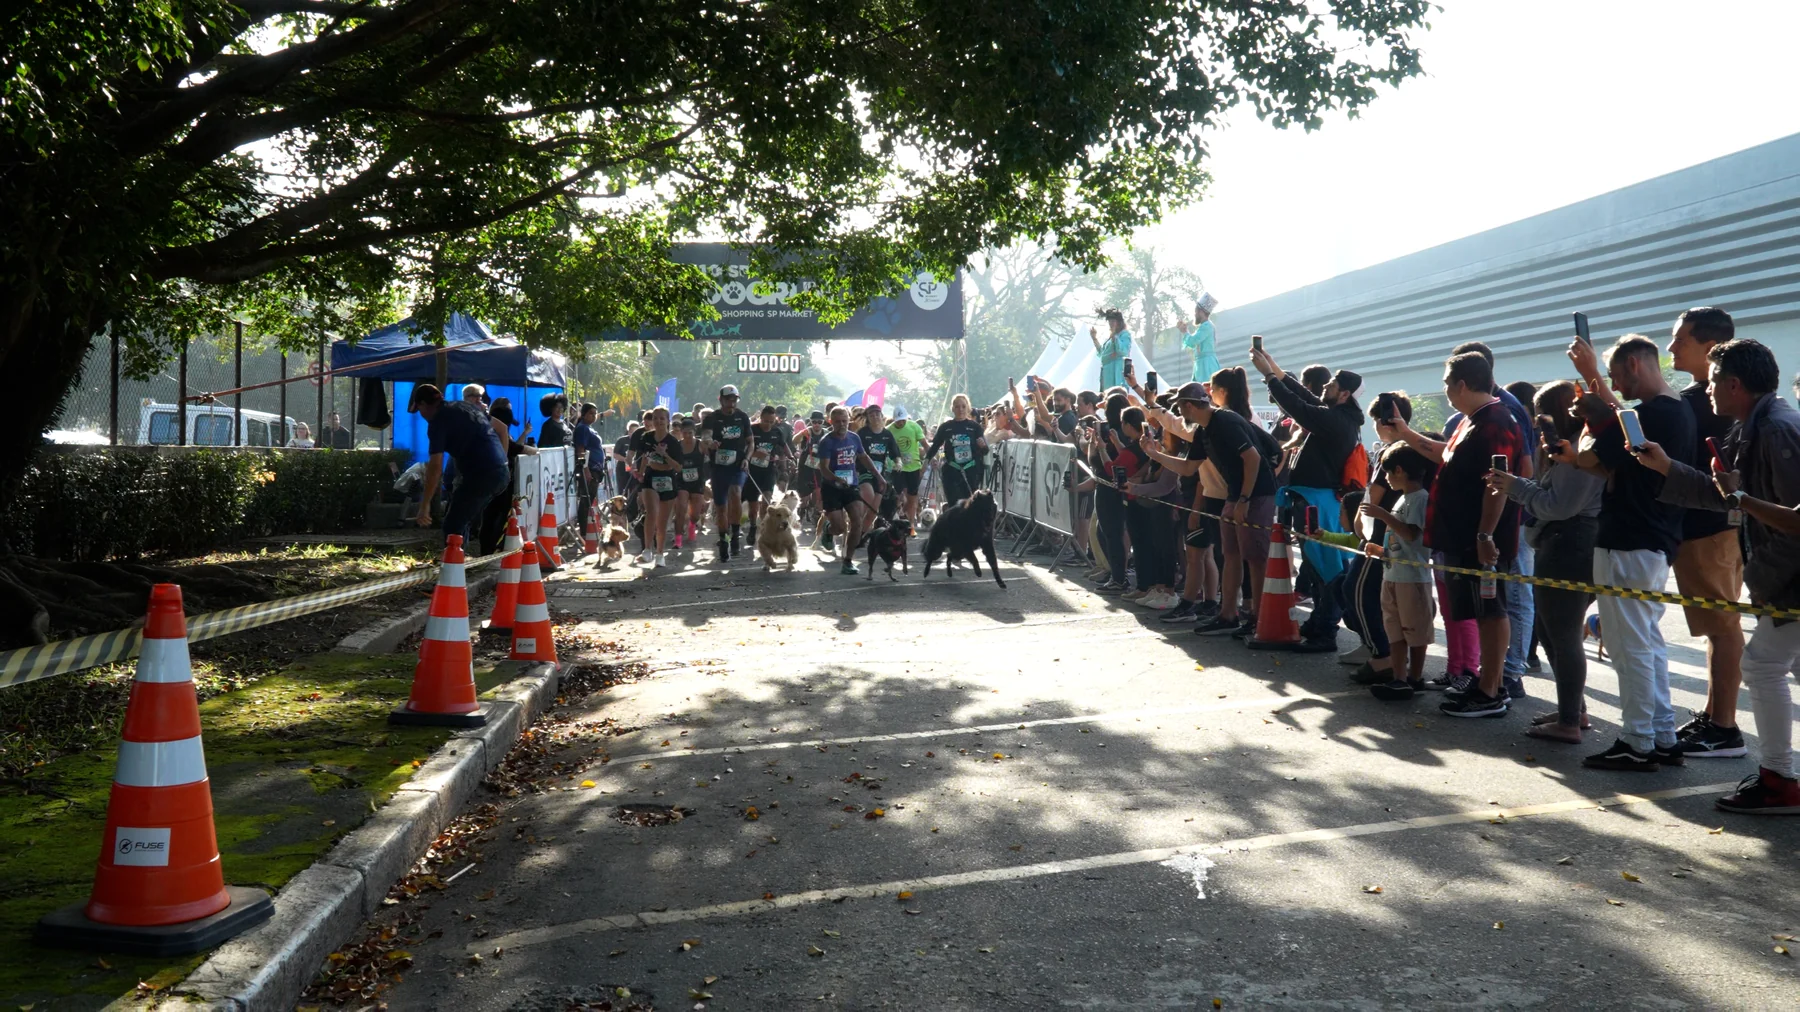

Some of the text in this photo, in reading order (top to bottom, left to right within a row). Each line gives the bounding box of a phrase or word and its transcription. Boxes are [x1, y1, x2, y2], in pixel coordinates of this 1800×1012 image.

[722, 310, 813, 318] SHOPPING SP MARKET
[738, 354, 799, 372] 000000
[134, 841, 165, 850] FUSE
